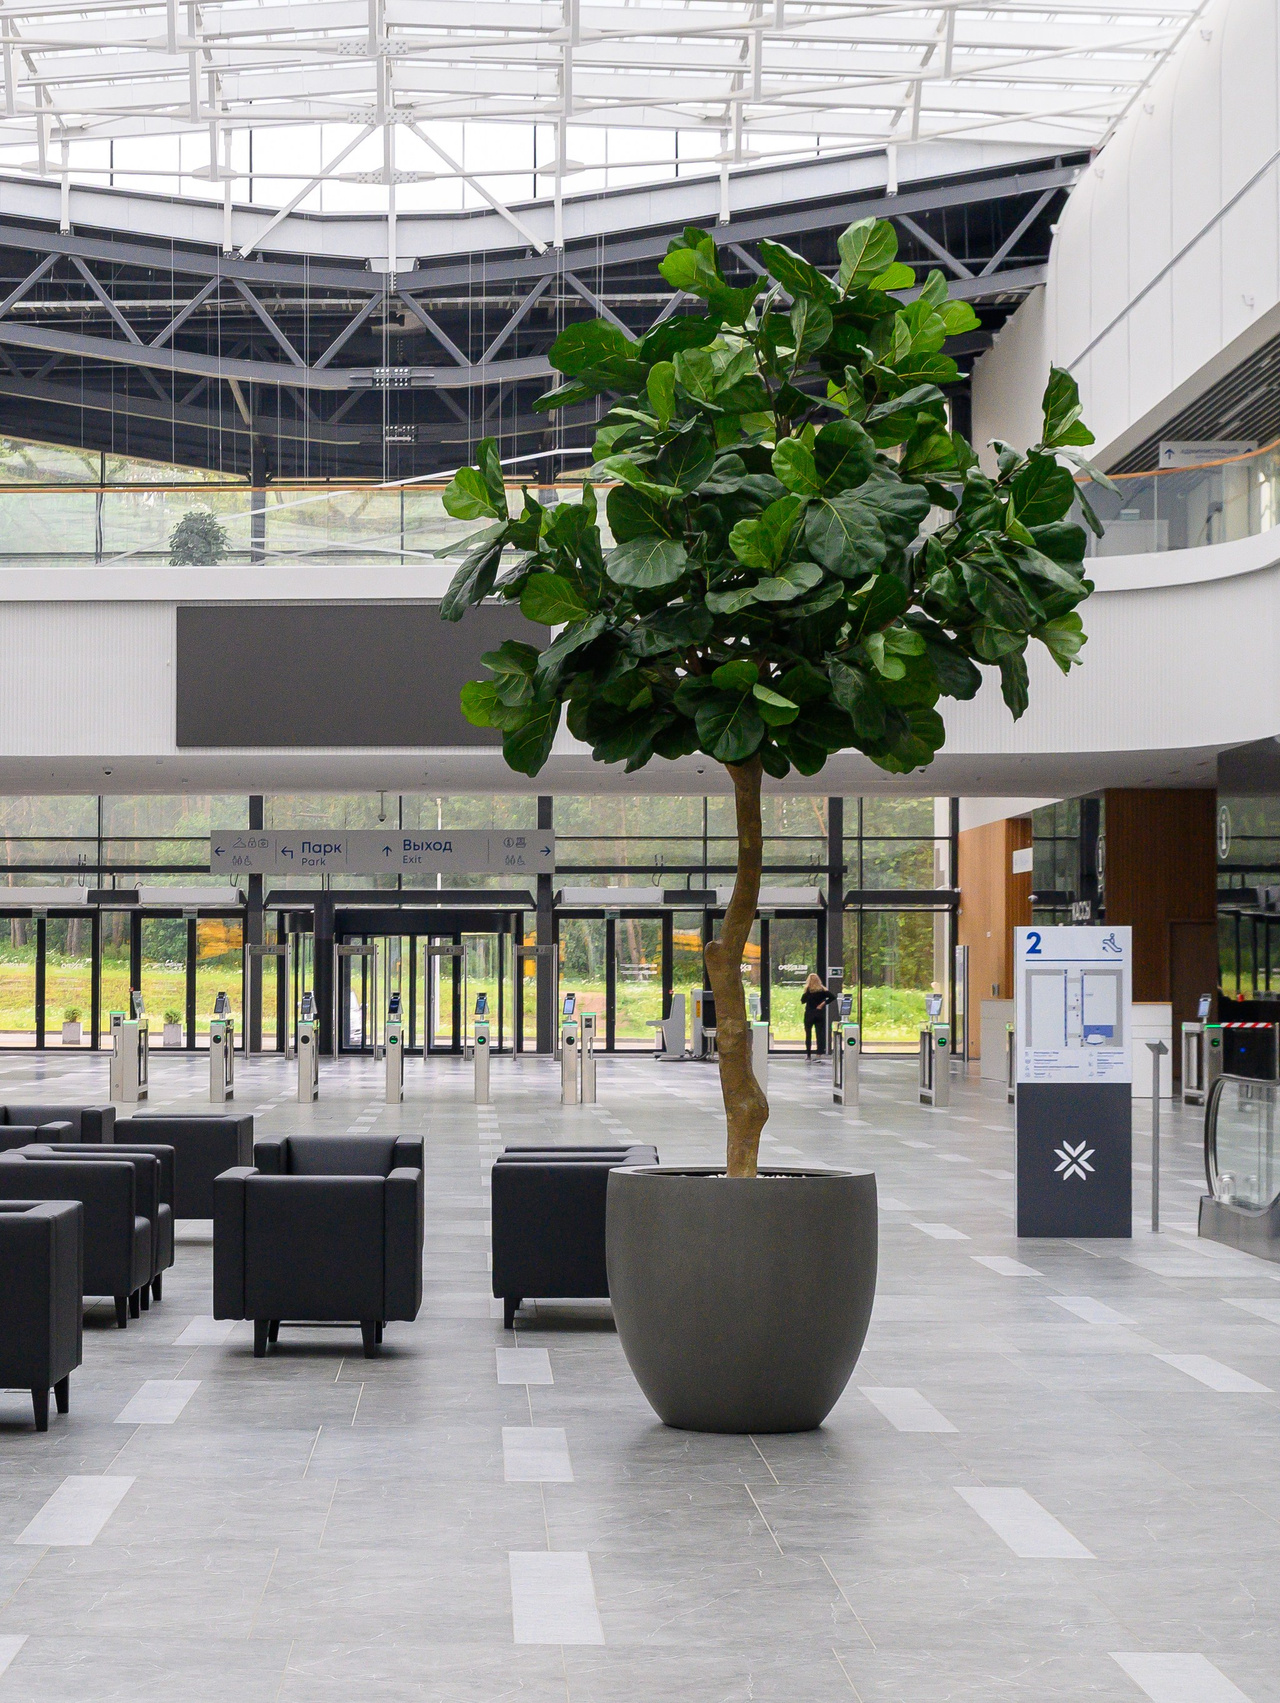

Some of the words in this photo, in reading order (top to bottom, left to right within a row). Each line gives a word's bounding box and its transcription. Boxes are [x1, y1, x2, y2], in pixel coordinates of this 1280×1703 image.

[301, 842, 342, 856] Парк
[402, 839, 453, 853] Выход
[301, 857, 326, 866] Park
[402, 855, 422, 864] Exit
[1026, 932, 1042, 954] 2
